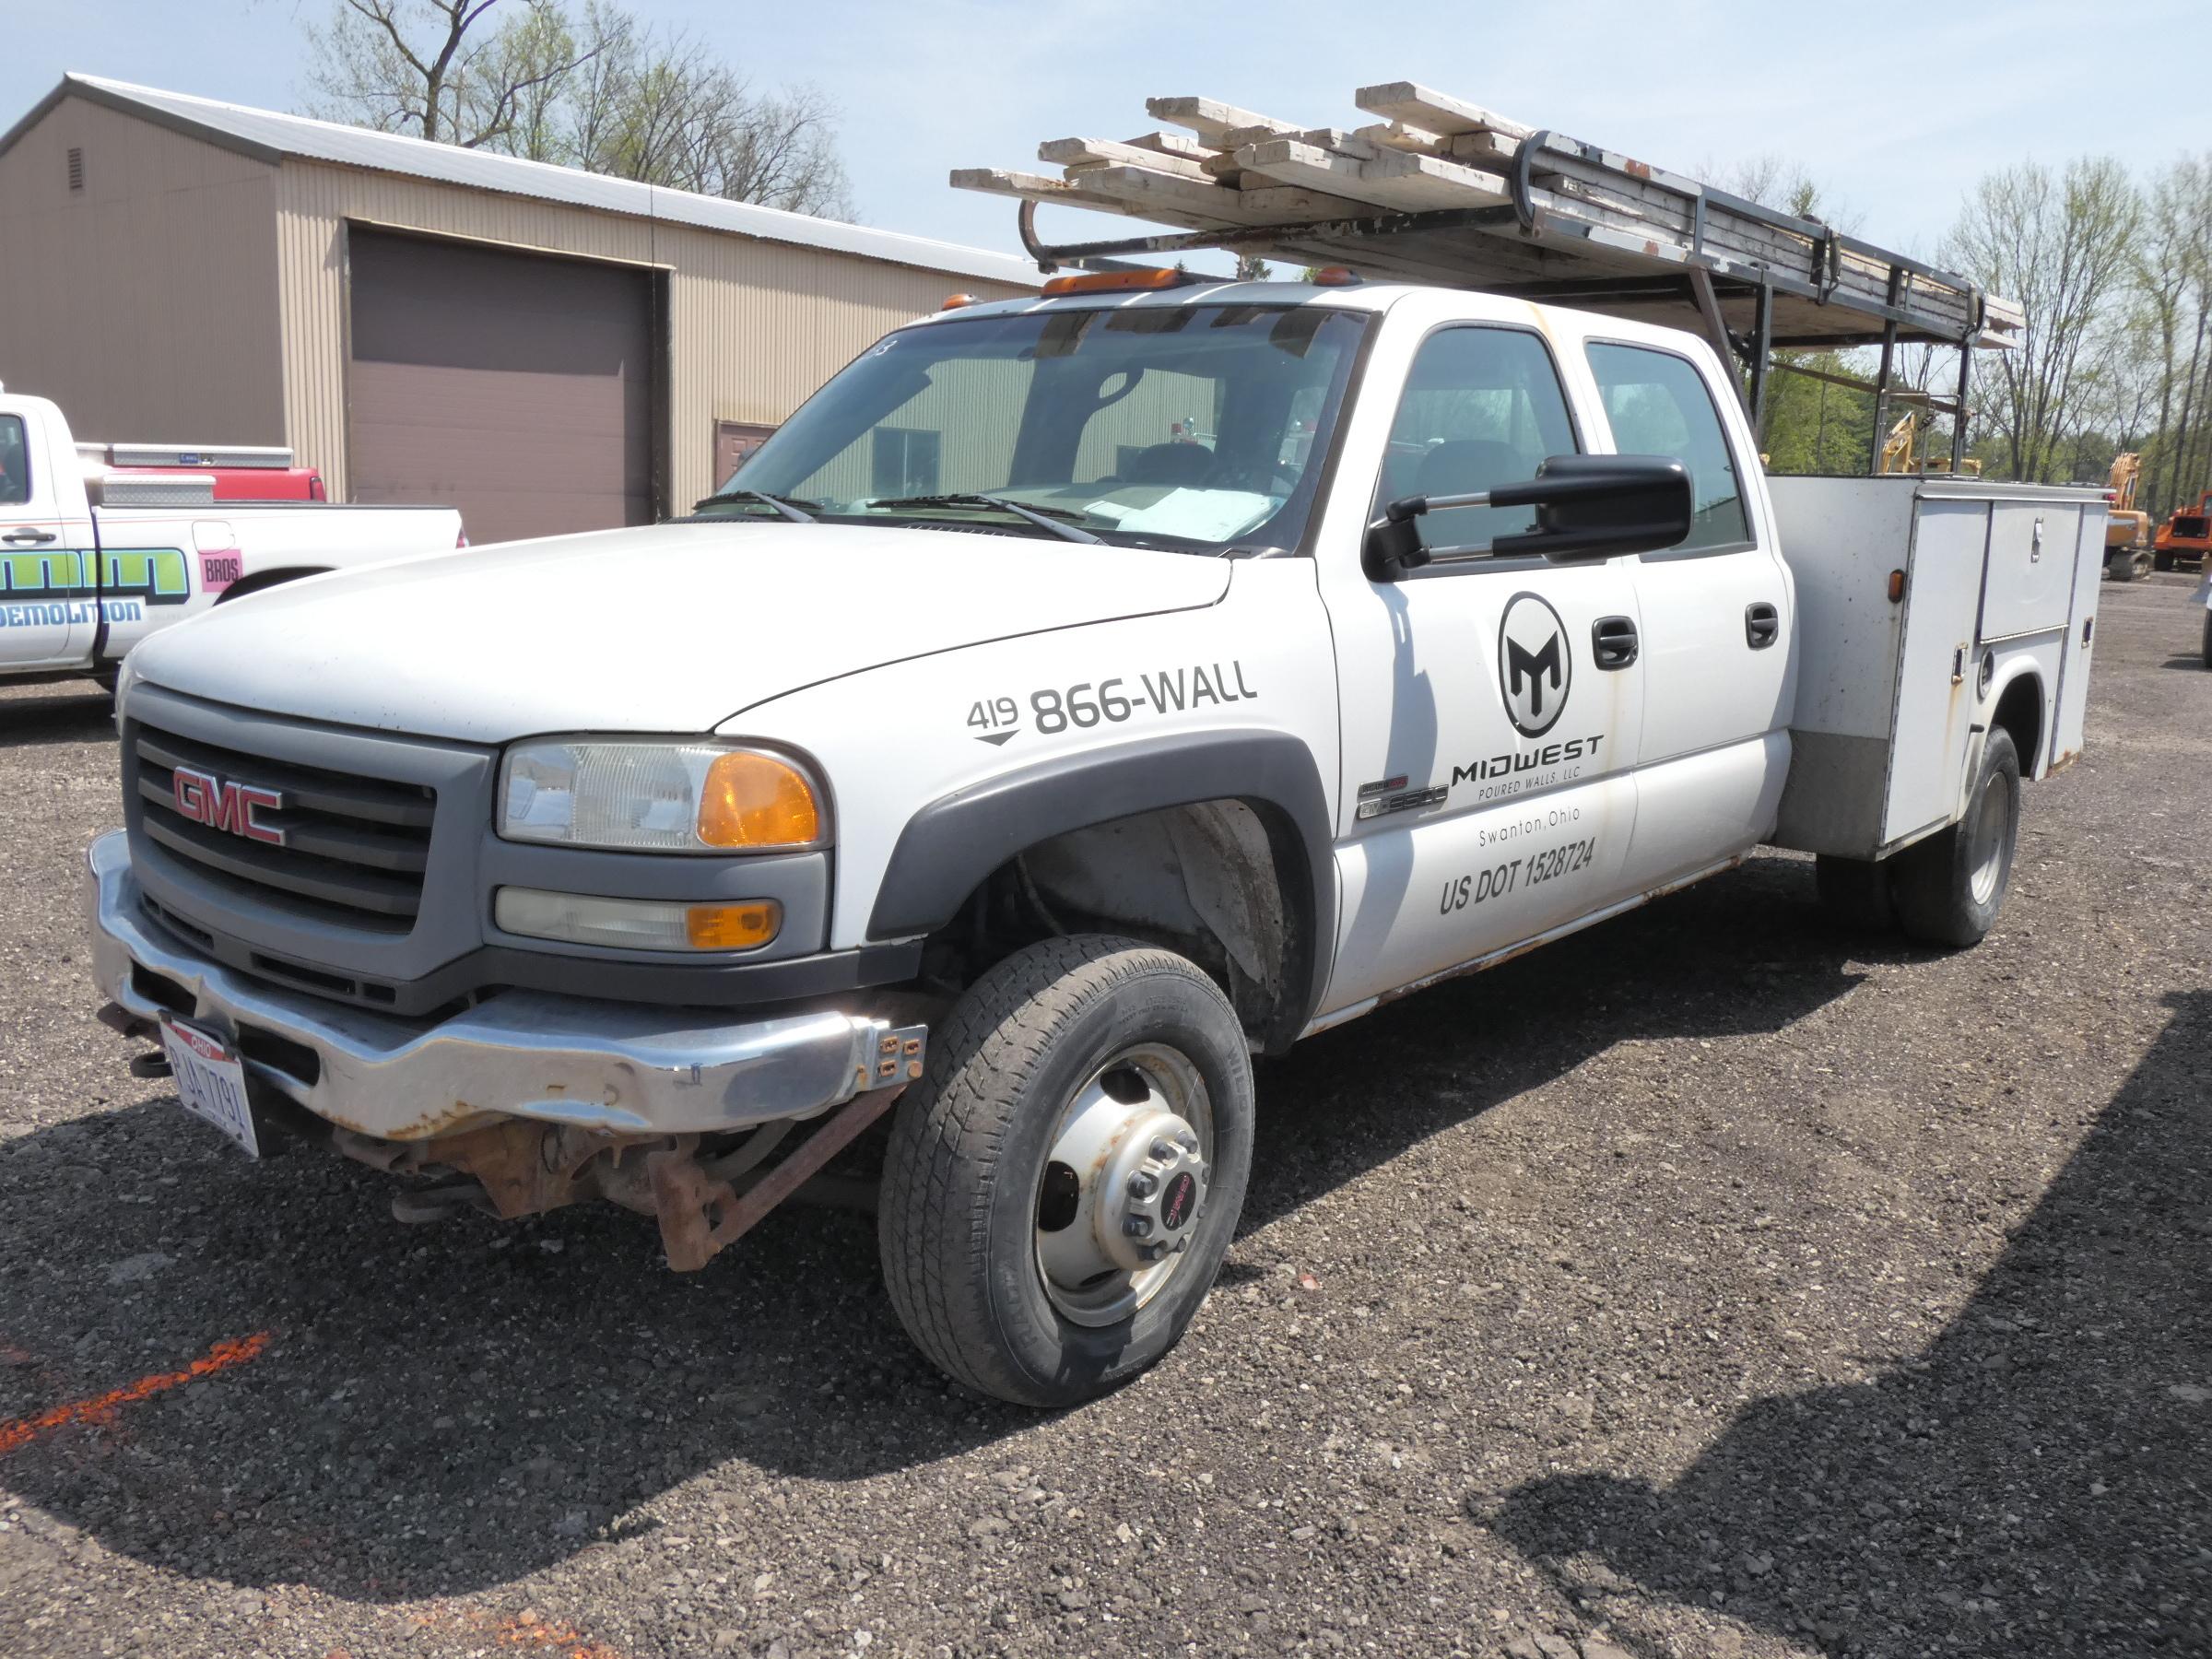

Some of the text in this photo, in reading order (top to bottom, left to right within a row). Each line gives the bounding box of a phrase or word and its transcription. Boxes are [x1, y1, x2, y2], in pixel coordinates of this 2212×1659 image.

[967, 660, 1258, 735] 419 866-WALL
[1452, 735, 1605, 787] MIDWEST
[1478, 781, 1521, 800] POURED
[1563, 766, 1581, 780] LLC
[172, 765, 287, 846] GMC
[1440, 836, 1596, 915] US DOT 1528724
[191, 1036, 212, 1058] OHIO
